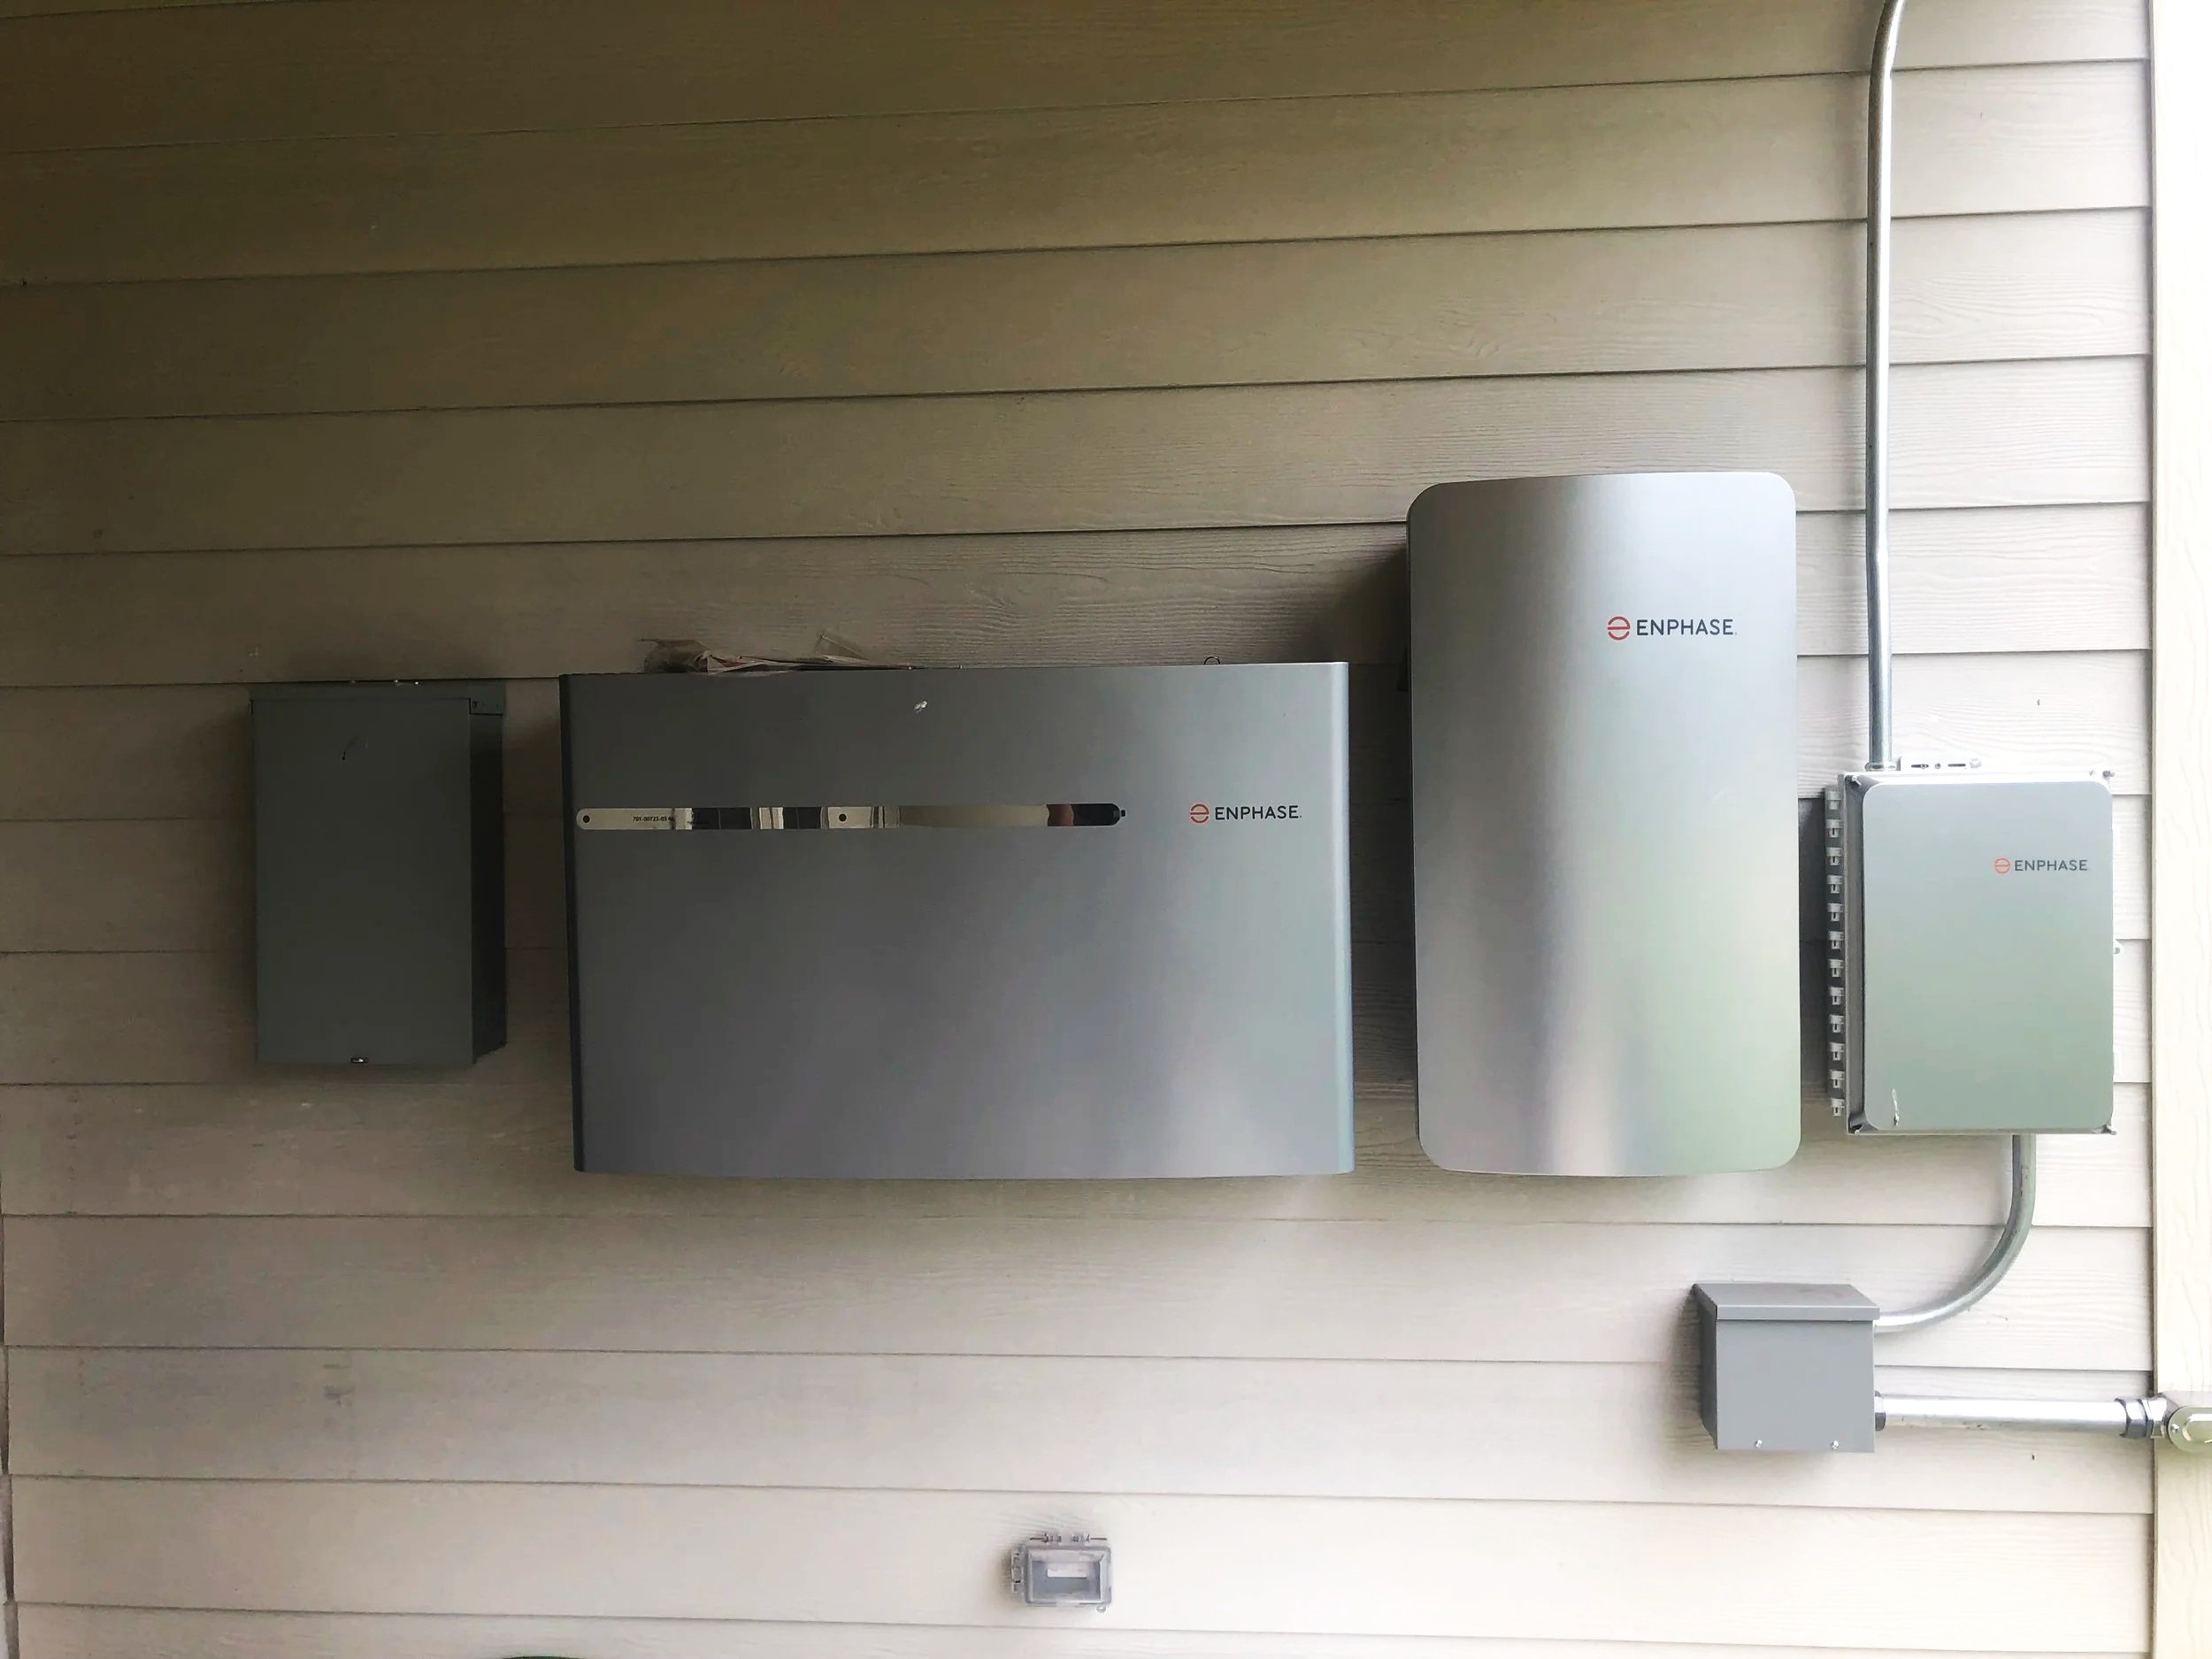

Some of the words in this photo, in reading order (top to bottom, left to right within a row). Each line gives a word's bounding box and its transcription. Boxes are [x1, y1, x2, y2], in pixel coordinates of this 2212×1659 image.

[1637, 618, 1734, 636] ENPHASE
[1215, 805, 1299, 820] ENPHASE
[2014, 859, 2088, 872] ENPHASE
